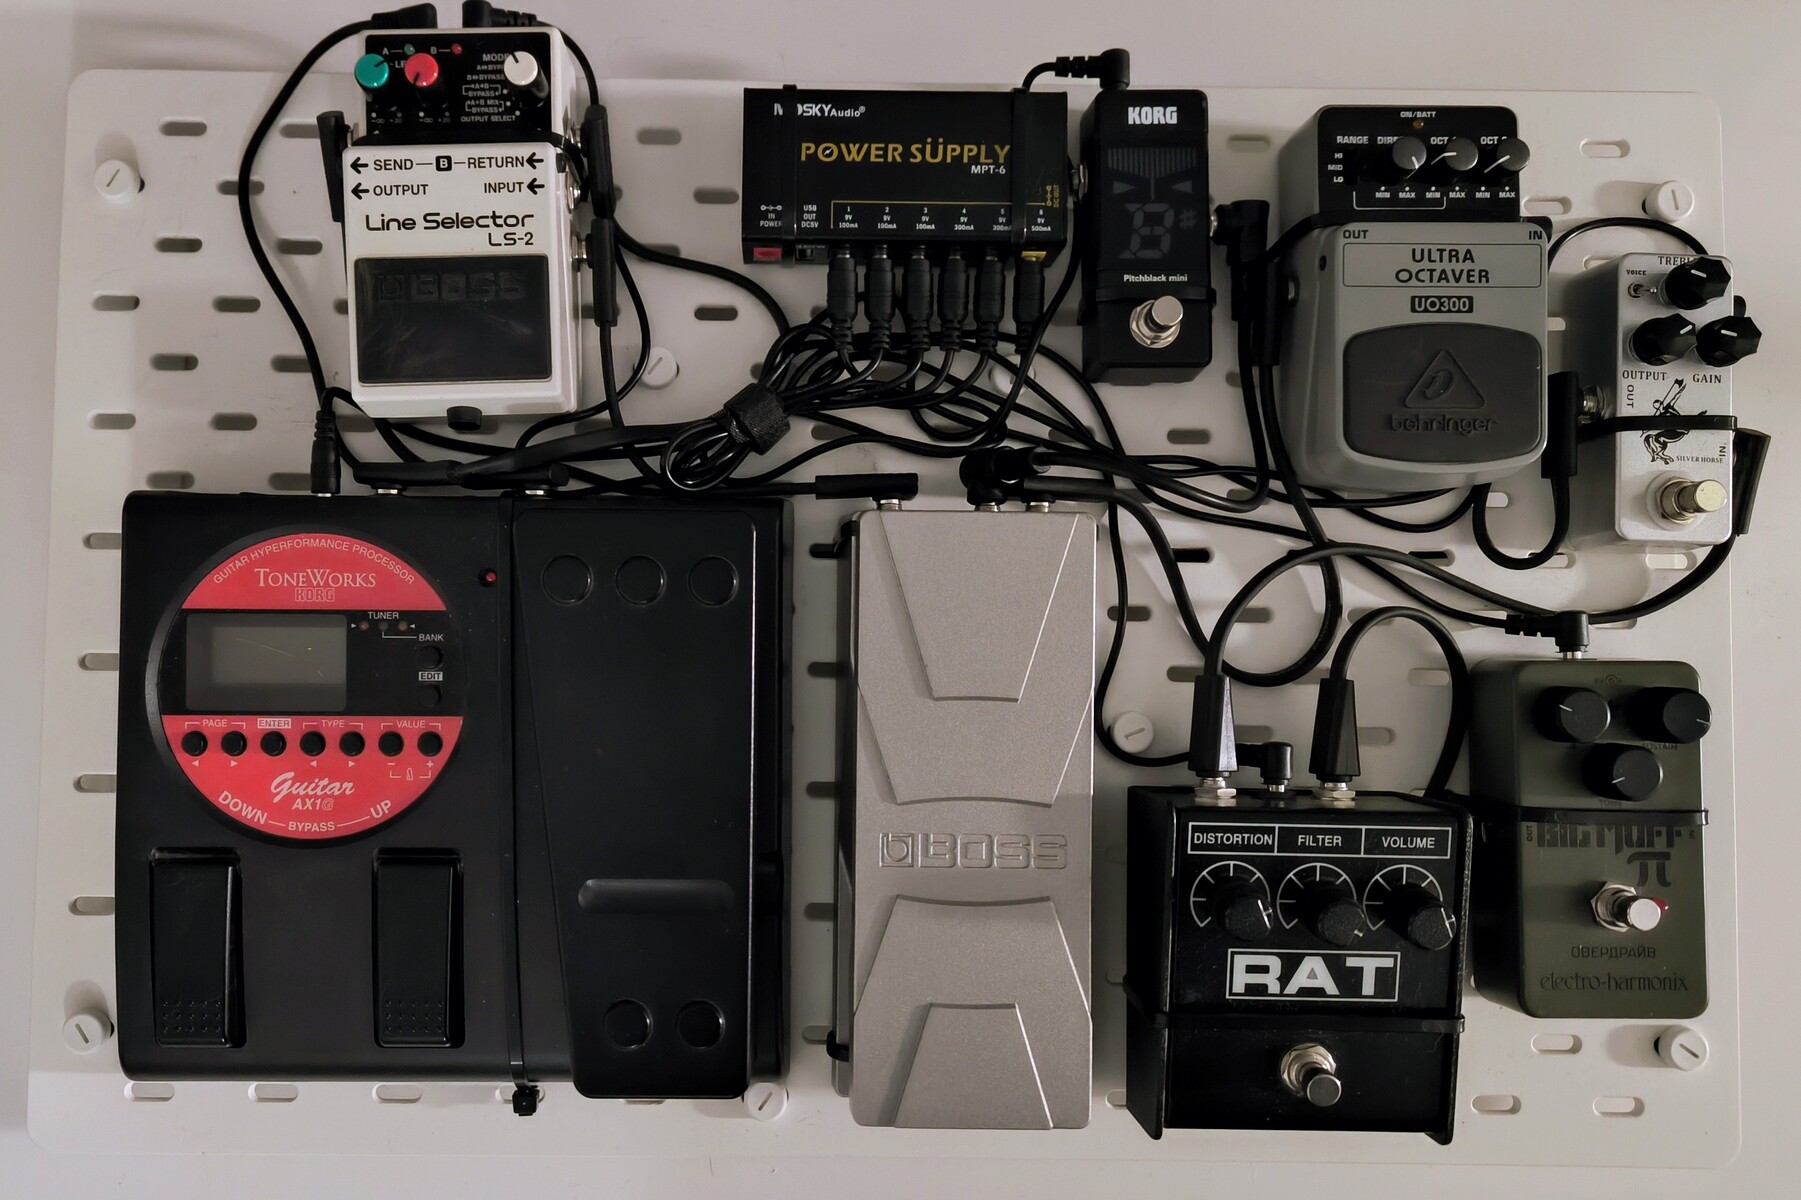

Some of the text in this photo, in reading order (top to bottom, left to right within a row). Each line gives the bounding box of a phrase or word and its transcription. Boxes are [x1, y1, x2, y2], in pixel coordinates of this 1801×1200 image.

[382, 47, 389, 55] A
[1128, 106, 1178, 125] KORG
[1336, 136, 1369, 144] RANGE
[1377, 136, 1400, 144] DIR
[1480, 136, 1498, 144] OCT
[800, 142, 903, 162] POWER
[373, 159, 414, 171] SEND
[467, 156, 525, 169] RETURN
[970, 165, 1006, 175] MPT-6
[373, 184, 428, 196] OUTPUT
[484, 182, 524, 194] INPUT
[365, 211, 535, 231] Line Selector
[488, 232, 534, 247] LS-2
[1343, 229, 1369, 239] OUT
[1528, 230, 1543, 240] IN
[1412, 248, 1475, 263] ULTRA
[1658, 256, 1697, 265] TREB
[1123, 274, 1188, 282] Pitchblack mini
[1395, 269, 1490, 283] OCTAVER
[1622, 370, 1667, 381] OUTPUT
[1692, 374, 1722, 384] GAIN
[1627, 384, 1635, 408] OUT
[1389, 413, 1497, 436] behringer
[1719, 445, 1726, 457] IN
[213, 538, 415, 585] GUITAR HYPERFORMANCE PROCESSOR
[295, 587, 335, 602] KORG
[368, 611, 399, 620] TUNER
[418, 634, 444, 642] BANK
[420, 671, 442, 681] EDIT
[203, 719, 227, 728] PAGE
[259, 719, 290, 728] ENTER
[321, 719, 345, 728] TYPE
[396, 720, 426, 729] VALUE
[270, 771, 355, 803] Guitar
[292, 798, 334, 811] AX1G
[218, 790, 392, 832] DOWN BYPASS UP
[1194, 833, 1273, 846] DISTORTION
[1298, 835, 1342, 847] FILTER
[1382, 836, 1435, 849] VOLUME
[918, 833, 1068, 869] BOSS
[1231, 954, 1395, 996] RAT
[1540, 971, 1689, 993] electro-harmonix
